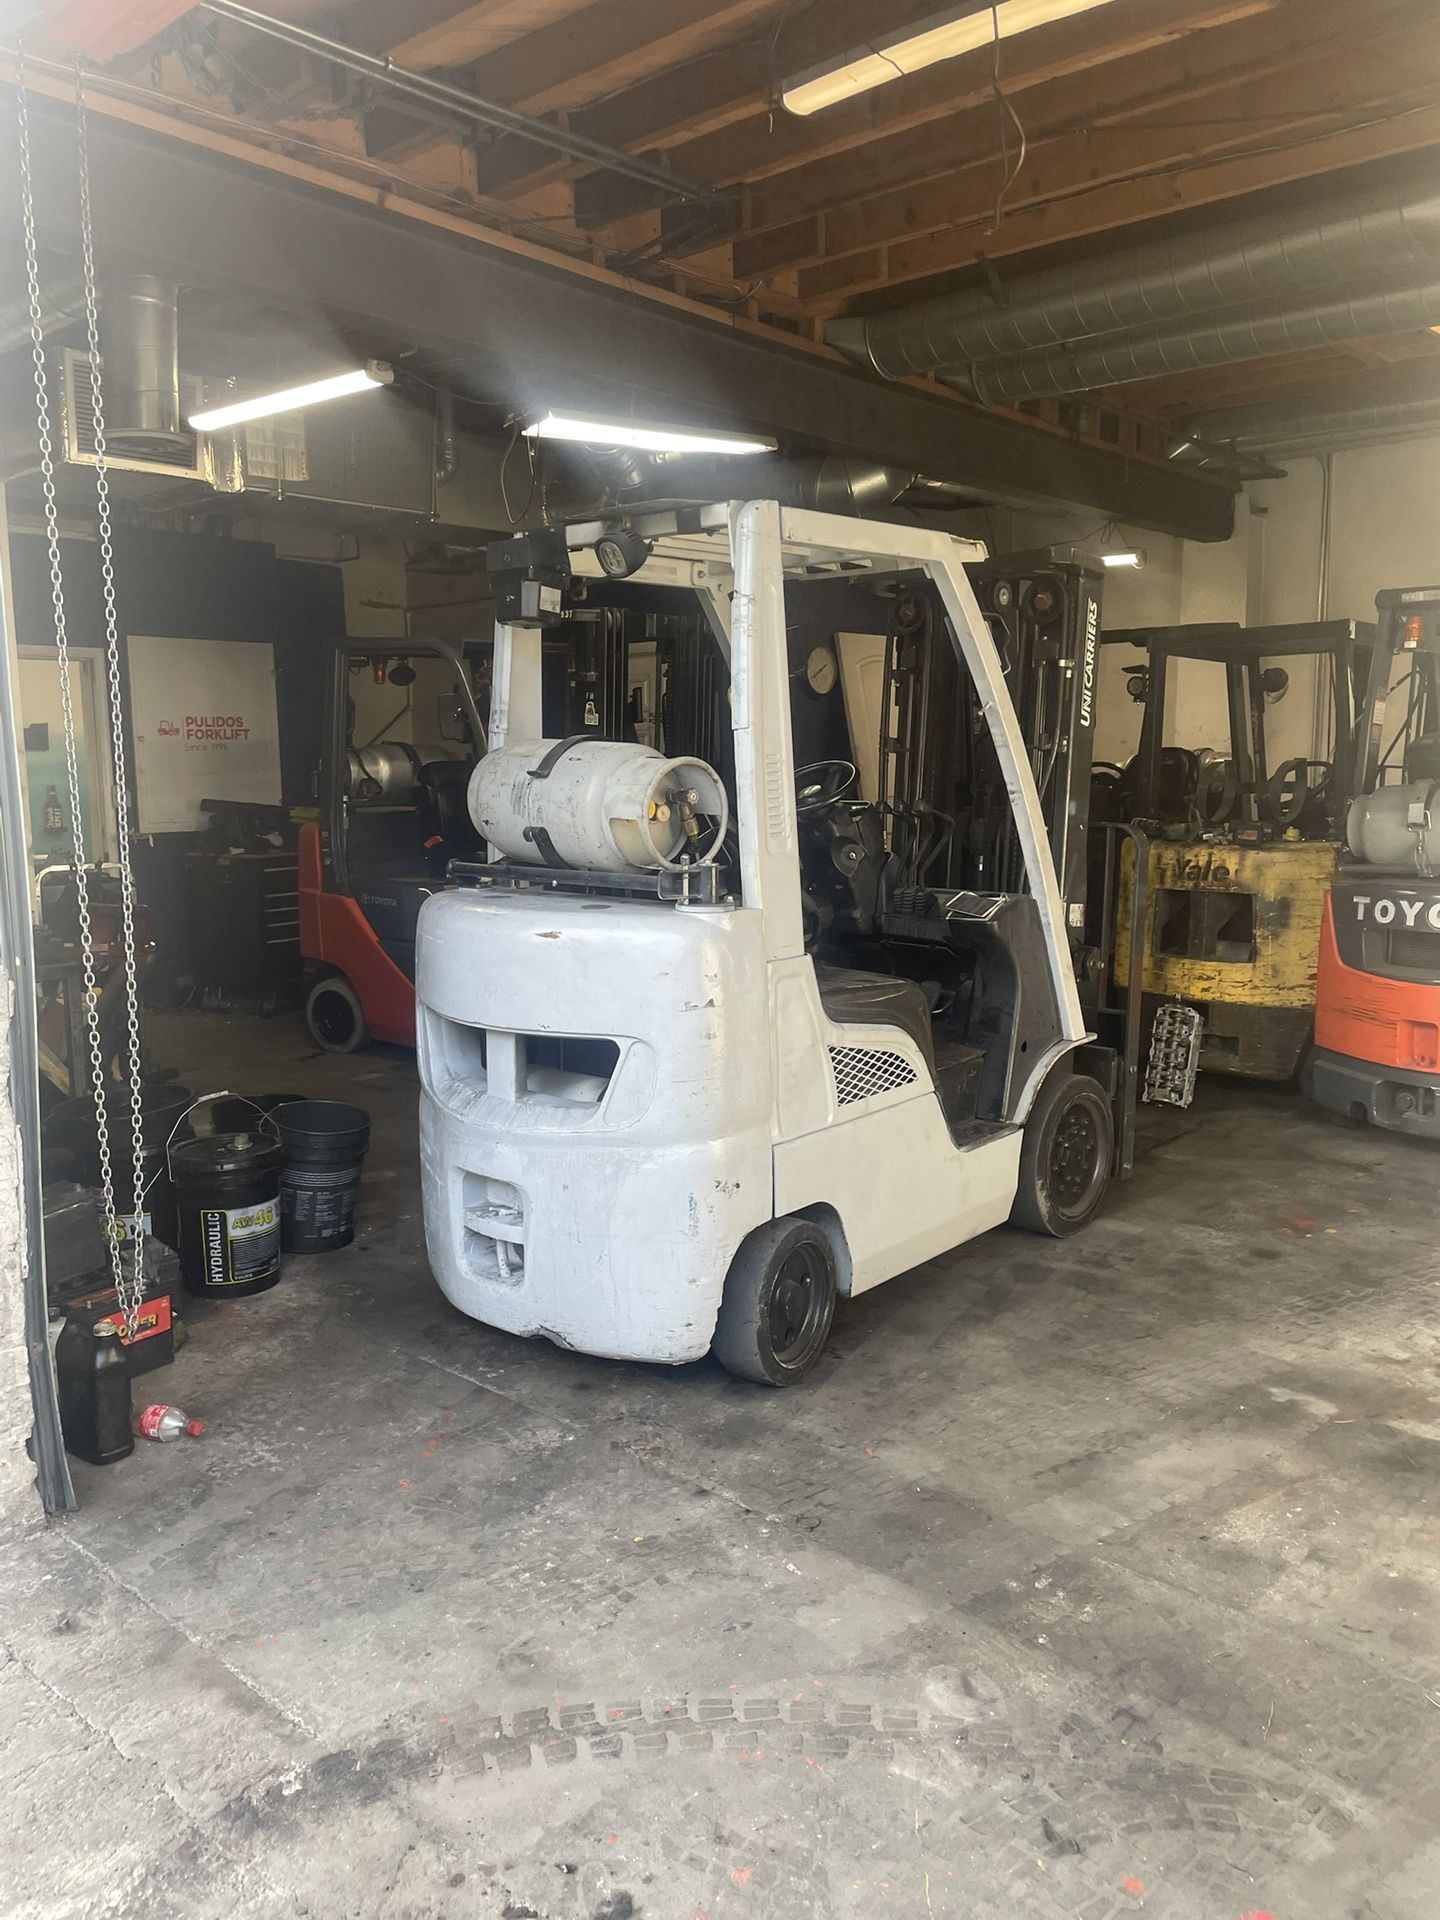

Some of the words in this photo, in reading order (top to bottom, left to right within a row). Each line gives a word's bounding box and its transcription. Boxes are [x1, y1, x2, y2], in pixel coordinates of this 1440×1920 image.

[1080, 597, 1098, 727] UNICARRIERS
[186, 716, 244, 728] PULIDOS
[186, 729, 250, 740] FORKLIFT
[184, 743, 208, 752] Since
[1176, 851, 1231, 882] Yale
[371, 896, 397, 906] TOYOTA
[254, 1206, 273, 1226] 46
[207, 1213, 224, 1282] HYDRAULIC
